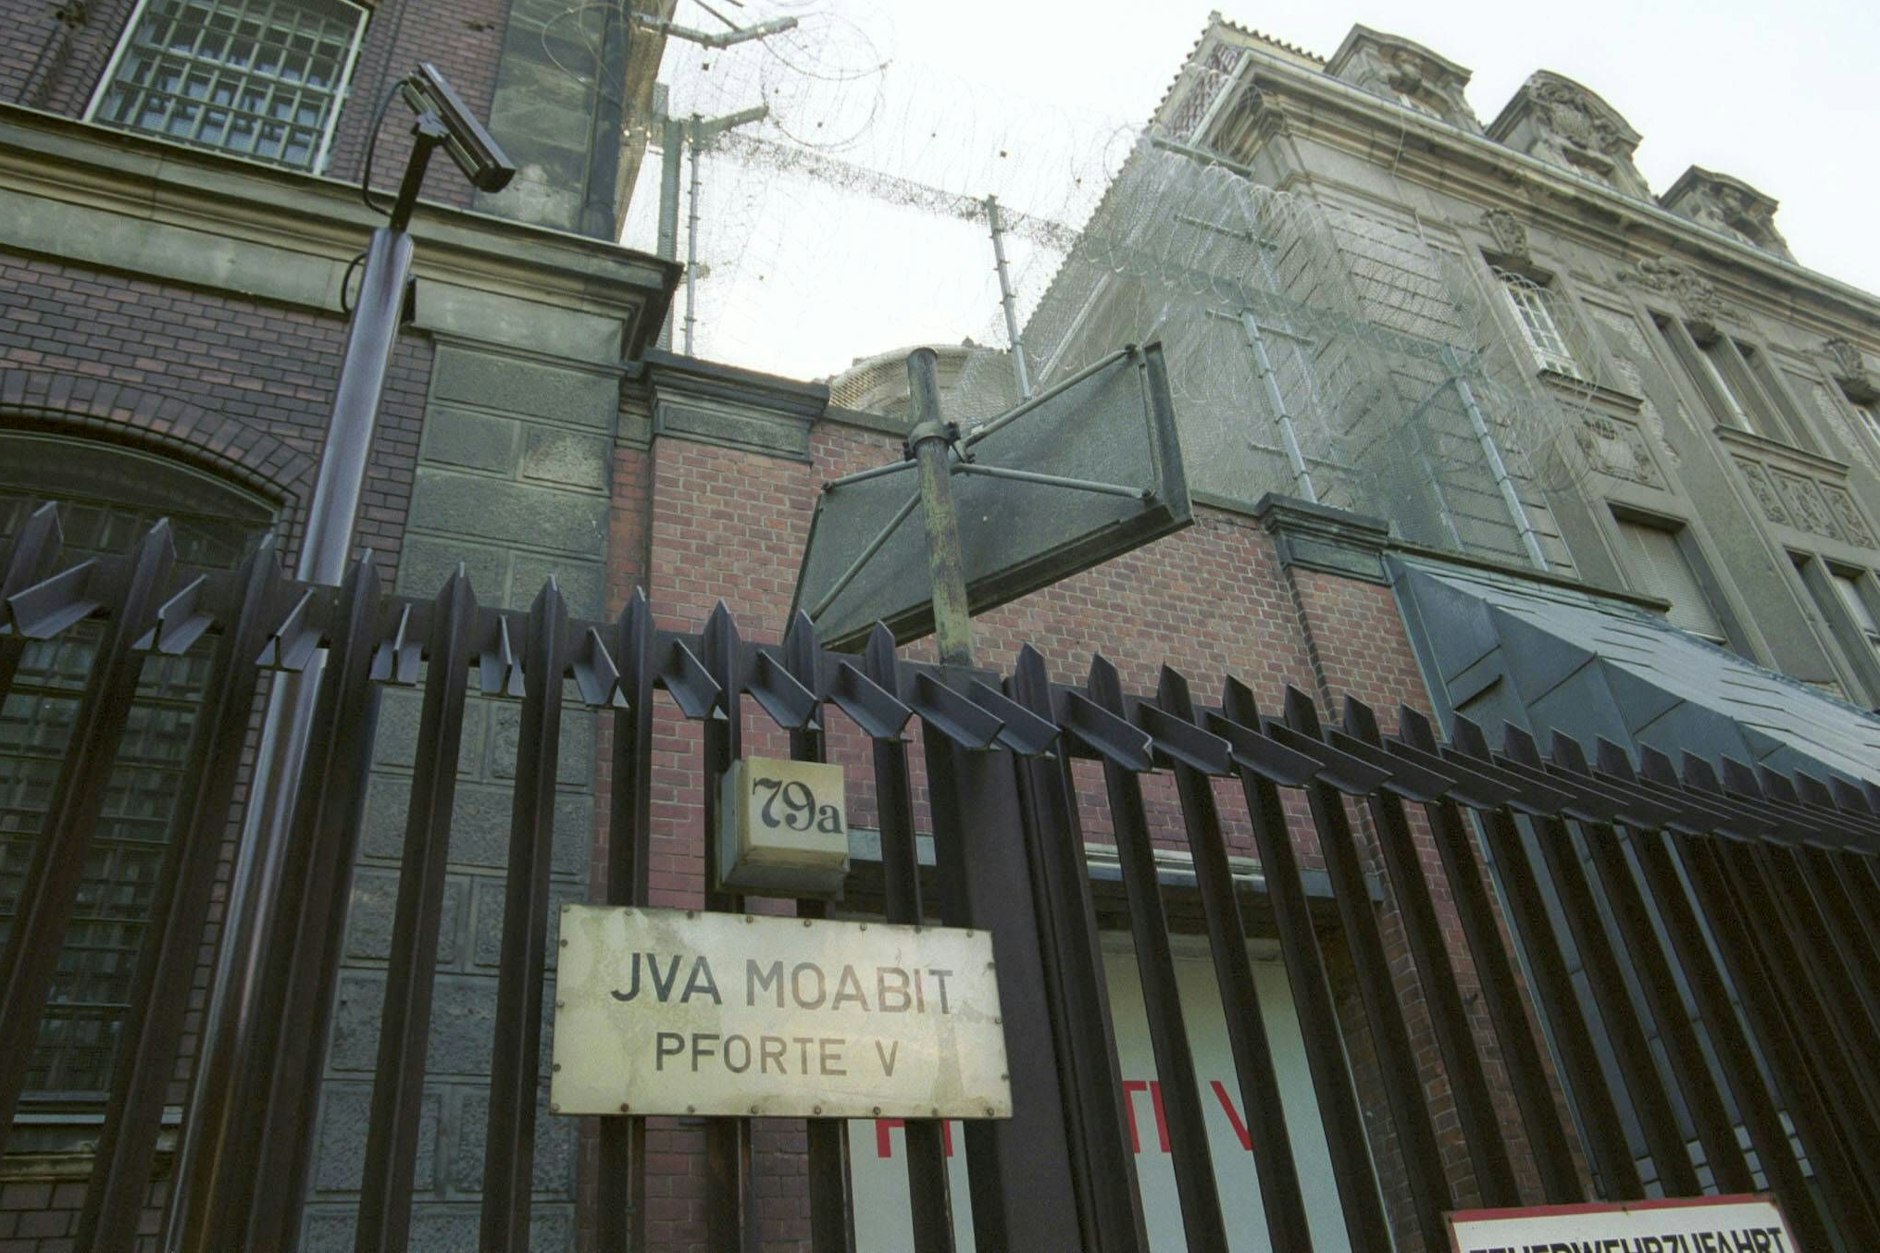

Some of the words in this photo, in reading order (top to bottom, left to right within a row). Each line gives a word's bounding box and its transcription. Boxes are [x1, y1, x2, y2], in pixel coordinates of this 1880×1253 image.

[752, 777, 844, 834] 79a
[610, 952, 723, 1005] JVA
[746, 958, 953, 1015] MOABIT
[656, 1032, 848, 1076] PFORTE
[874, 1039, 899, 1077] V
